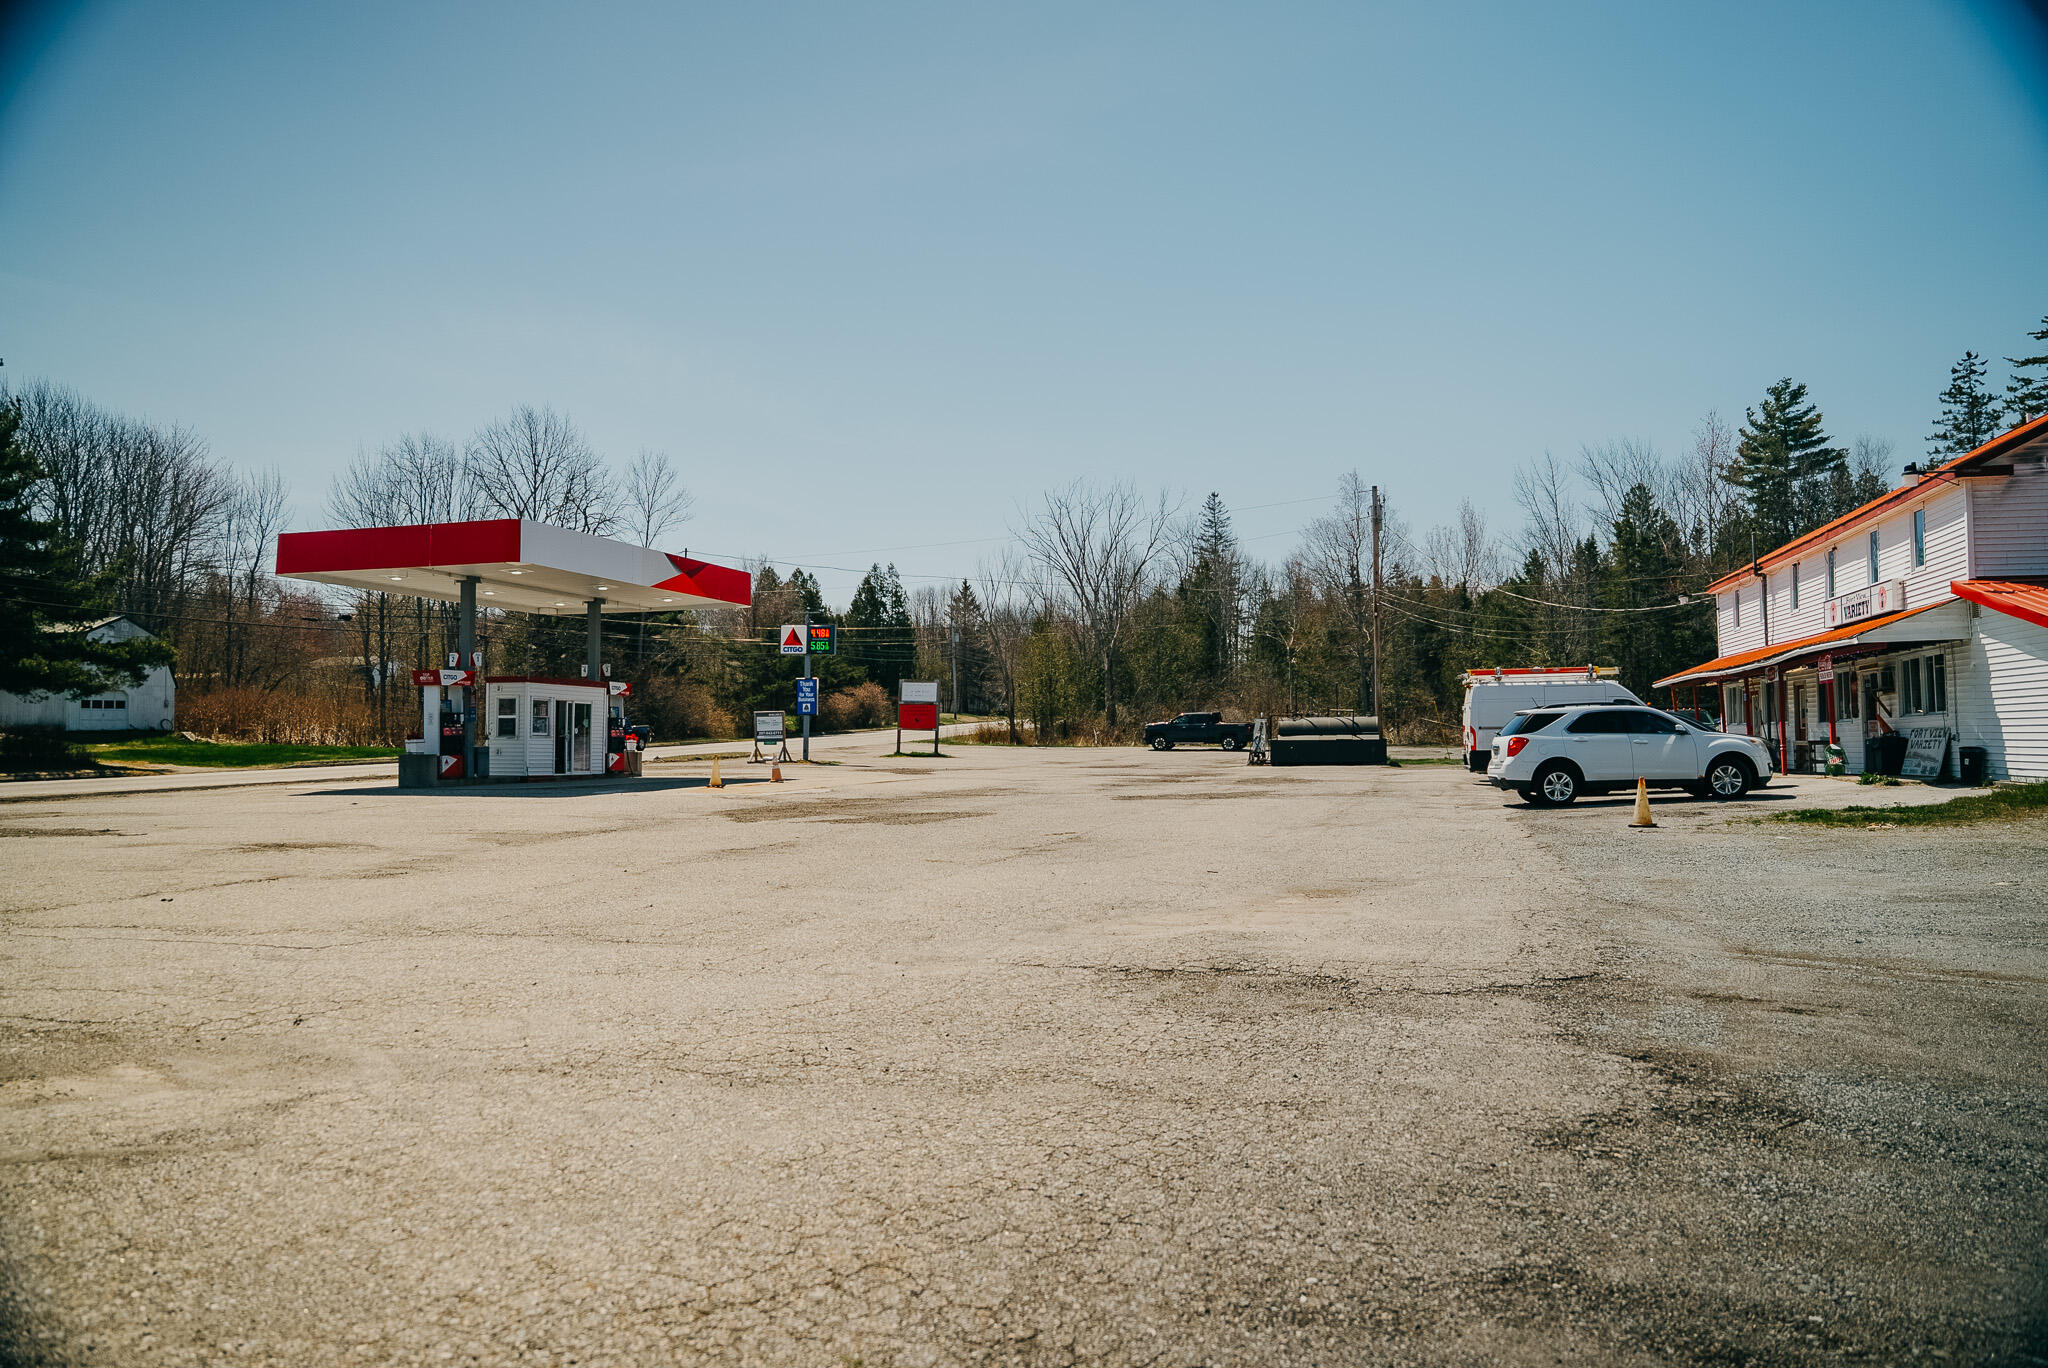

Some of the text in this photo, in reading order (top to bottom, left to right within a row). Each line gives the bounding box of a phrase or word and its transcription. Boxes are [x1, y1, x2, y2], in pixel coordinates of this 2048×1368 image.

[1843, 599, 1870, 620] VARIETY
[1910, 728, 1929, 738] FORT
[1910, 739, 1943, 750] VARIETY
